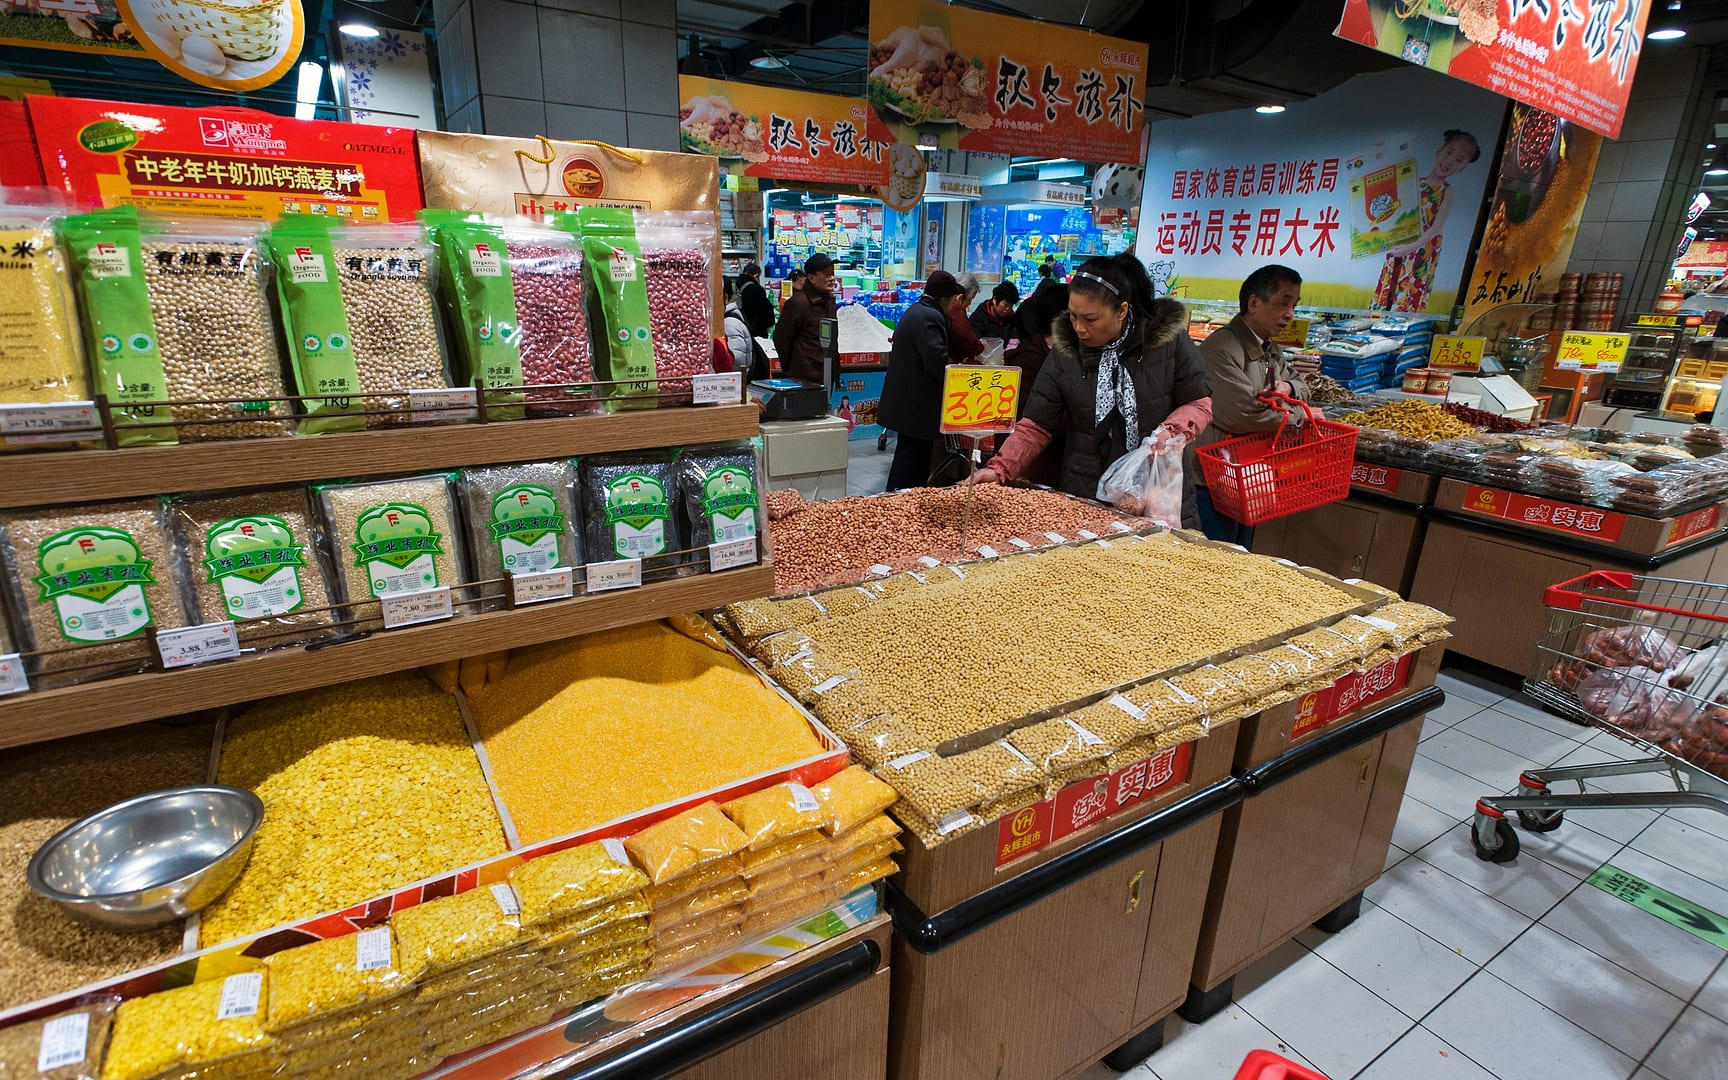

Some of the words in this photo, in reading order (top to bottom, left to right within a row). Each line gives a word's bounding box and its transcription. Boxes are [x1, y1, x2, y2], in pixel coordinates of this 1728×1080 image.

[1113, 51, 1142, 65] 永辉超市
[995, 57, 1143, 131] 秋冬滋补
[343, 143, 405, 155] OATMEAL
[135, 156, 361, 193] 中老年牛奶加钙燕麦片
[1170, 158, 1340, 200] 国家体育总局训练局
[1154, 205, 1341, 259] 运动员专用大米
[967, 371, 1005, 390] 黄豆
[324, 396, 350, 409] 1kg
[946, 384, 1016, 422] 3.28
[1351, 465, 1387, 485] 实惠
[1551, 507, 1604, 531] 实惠
[218, 549, 294, 569] 辉业有机
[1115, 746, 1177, 806] 实惠
[1014, 809, 1035, 832] YH
[1073, 805, 1107, 828] BENEFITS
[1000, 830, 1042, 857] 永辉超市
[1604, 873, 1628, 892] EXIT
